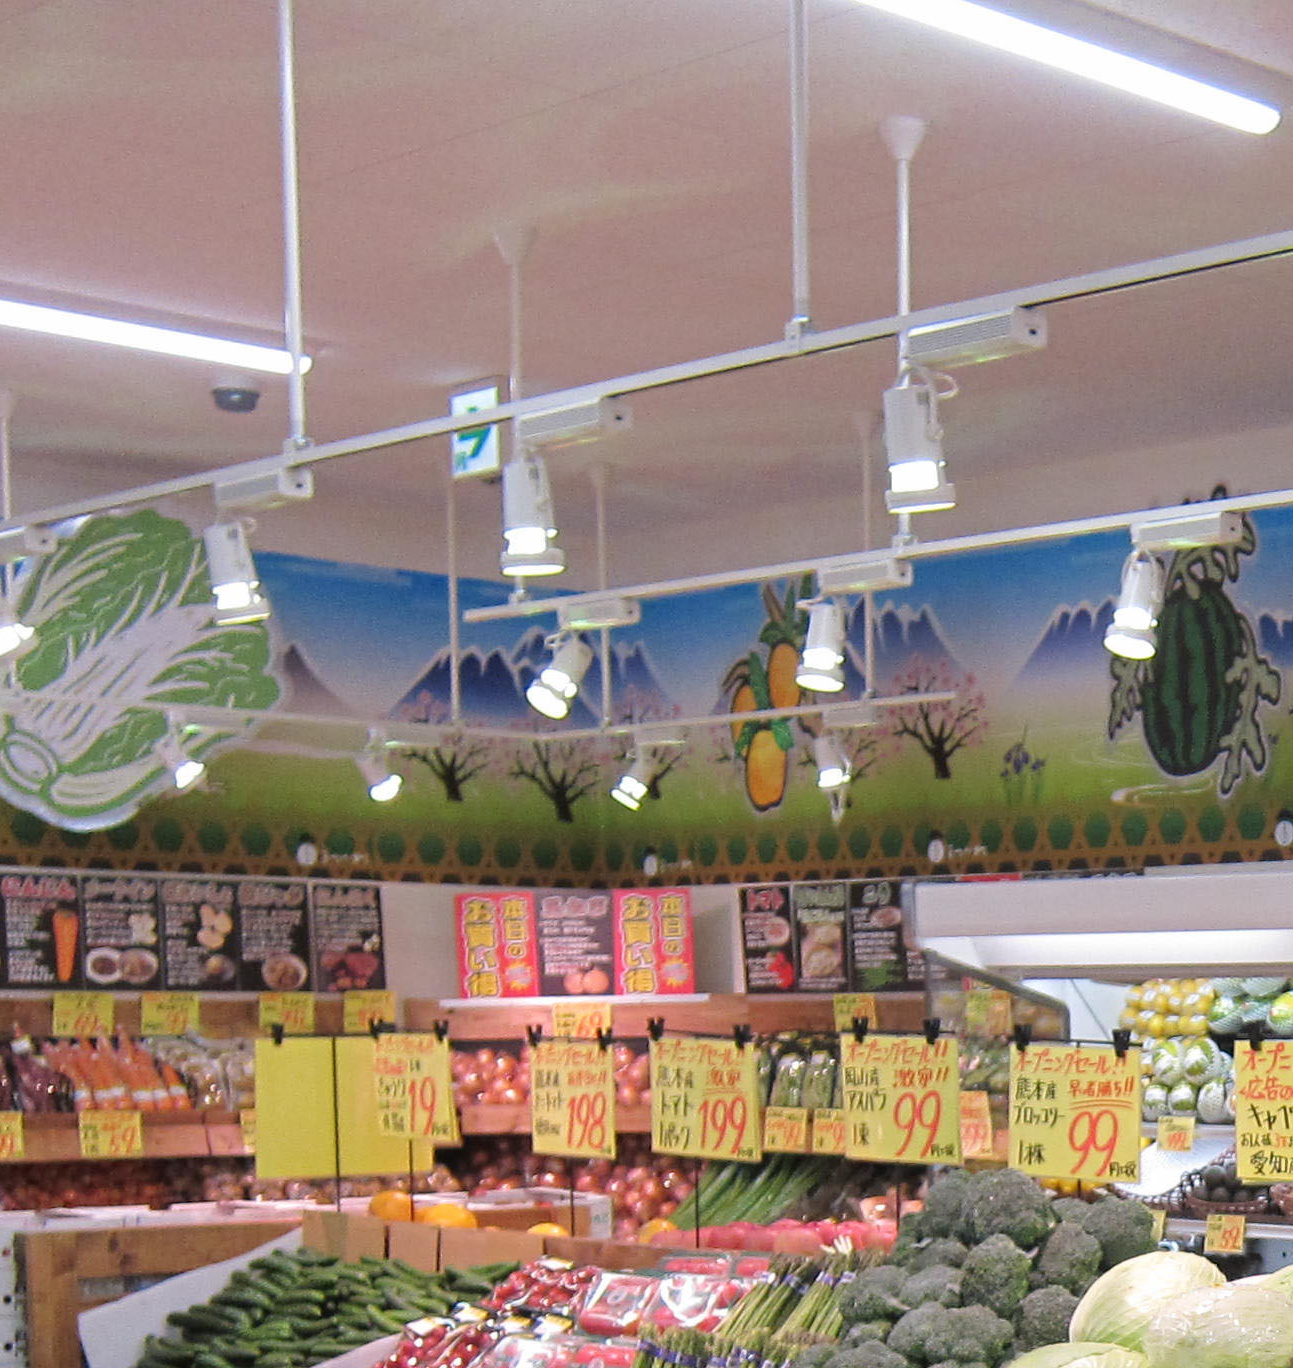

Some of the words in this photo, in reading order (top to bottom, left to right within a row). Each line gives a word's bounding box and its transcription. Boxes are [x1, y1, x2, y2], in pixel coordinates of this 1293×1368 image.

[465, 898, 500, 997] お買い得
[501, 898, 528, 959] 本日の
[622, 895, 657, 993] お買い得
[659, 895, 685, 956] 本日の
[408, 1077, 436, 1135] 19
[567, 1092, 606, 1149] 198
[660, 1091, 692, 1117] トマト
[698, 1096, 747, 1153] 199
[893, 1090, 941, 1157] 99
[1014, 1102, 1065, 1127] ブロッコリー
[1018, 1139, 1045, 1165] 1株
[1068, 1110, 1119, 1176] 99
